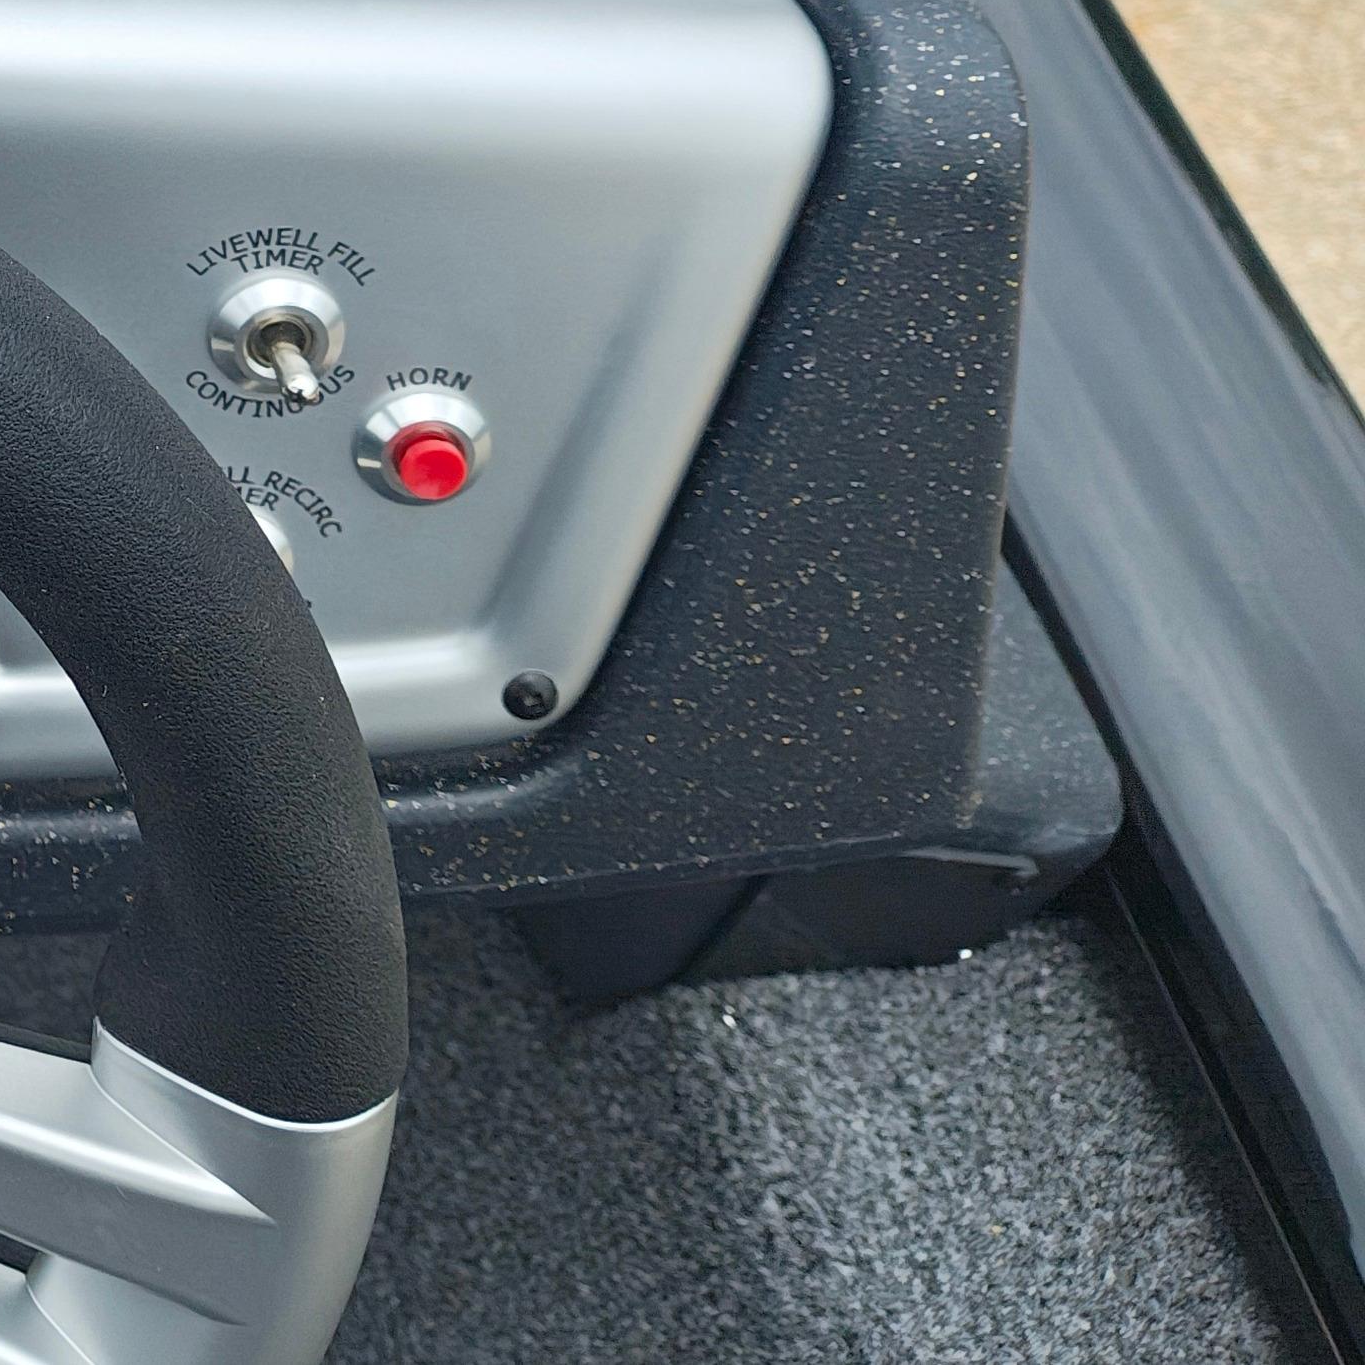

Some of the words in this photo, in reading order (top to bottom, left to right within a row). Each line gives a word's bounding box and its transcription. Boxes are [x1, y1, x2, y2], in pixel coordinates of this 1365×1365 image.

[186, 227, 320, 276] LIVEWELL
[327, 241, 376, 287] FILL
[230, 248, 325, 276] TIMER
[386, 366, 473, 392] HORN
[263, 470, 343, 538] RECIRC
